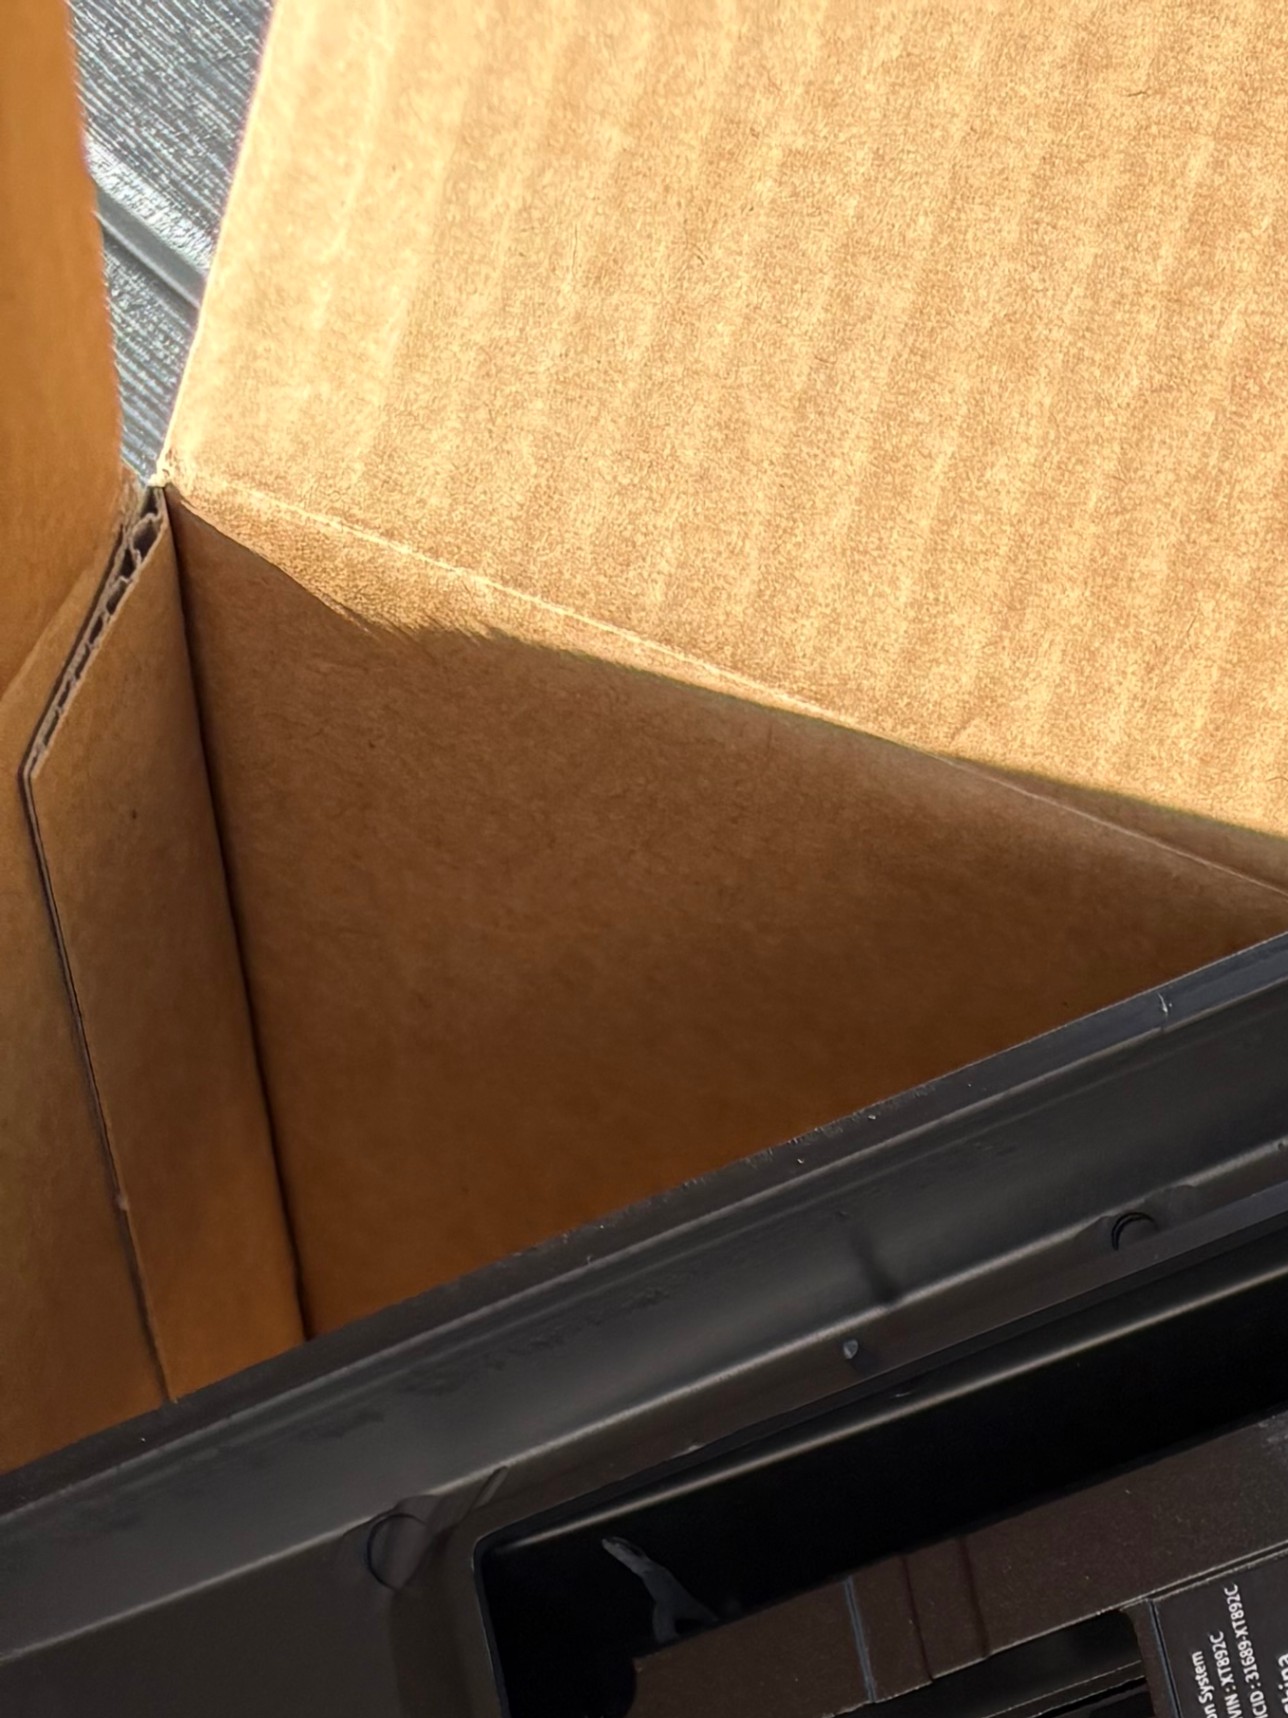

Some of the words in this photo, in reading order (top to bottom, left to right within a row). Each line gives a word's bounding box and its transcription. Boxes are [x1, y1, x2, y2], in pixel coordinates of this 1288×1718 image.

[1209, 1631, 1235, 1687] XT892C
[1223, 1584, 1260, 1683] 31689-XT892C
[1191, 1650, 1215, 1704] System
